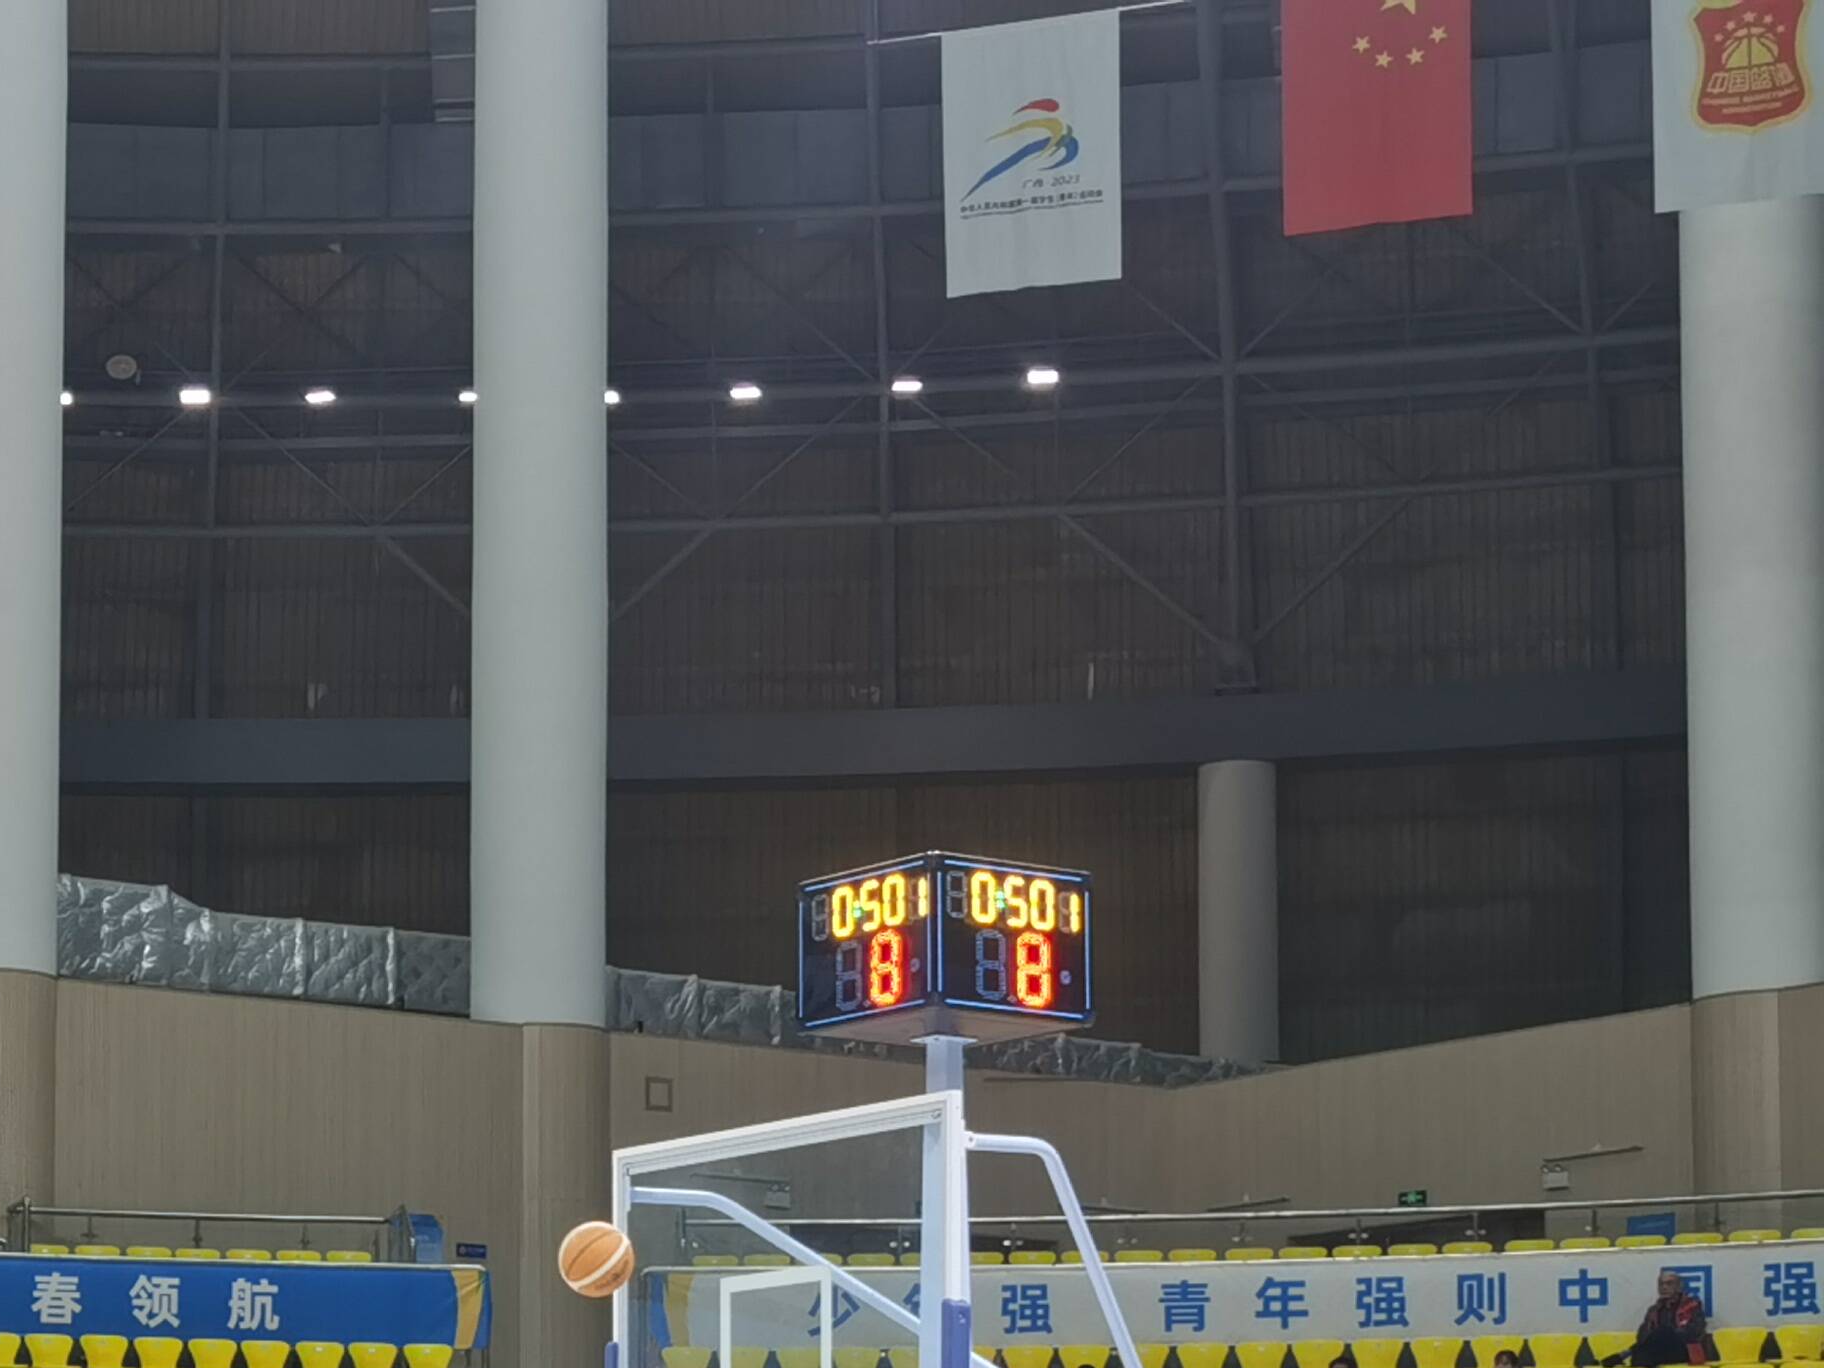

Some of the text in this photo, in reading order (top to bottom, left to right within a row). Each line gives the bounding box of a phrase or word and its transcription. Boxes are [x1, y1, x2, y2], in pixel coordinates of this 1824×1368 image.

[869, 928, 904, 1006] 8
[1015, 931, 1052, 1008] 8
[808, 1283, 1053, 1337] 少强
